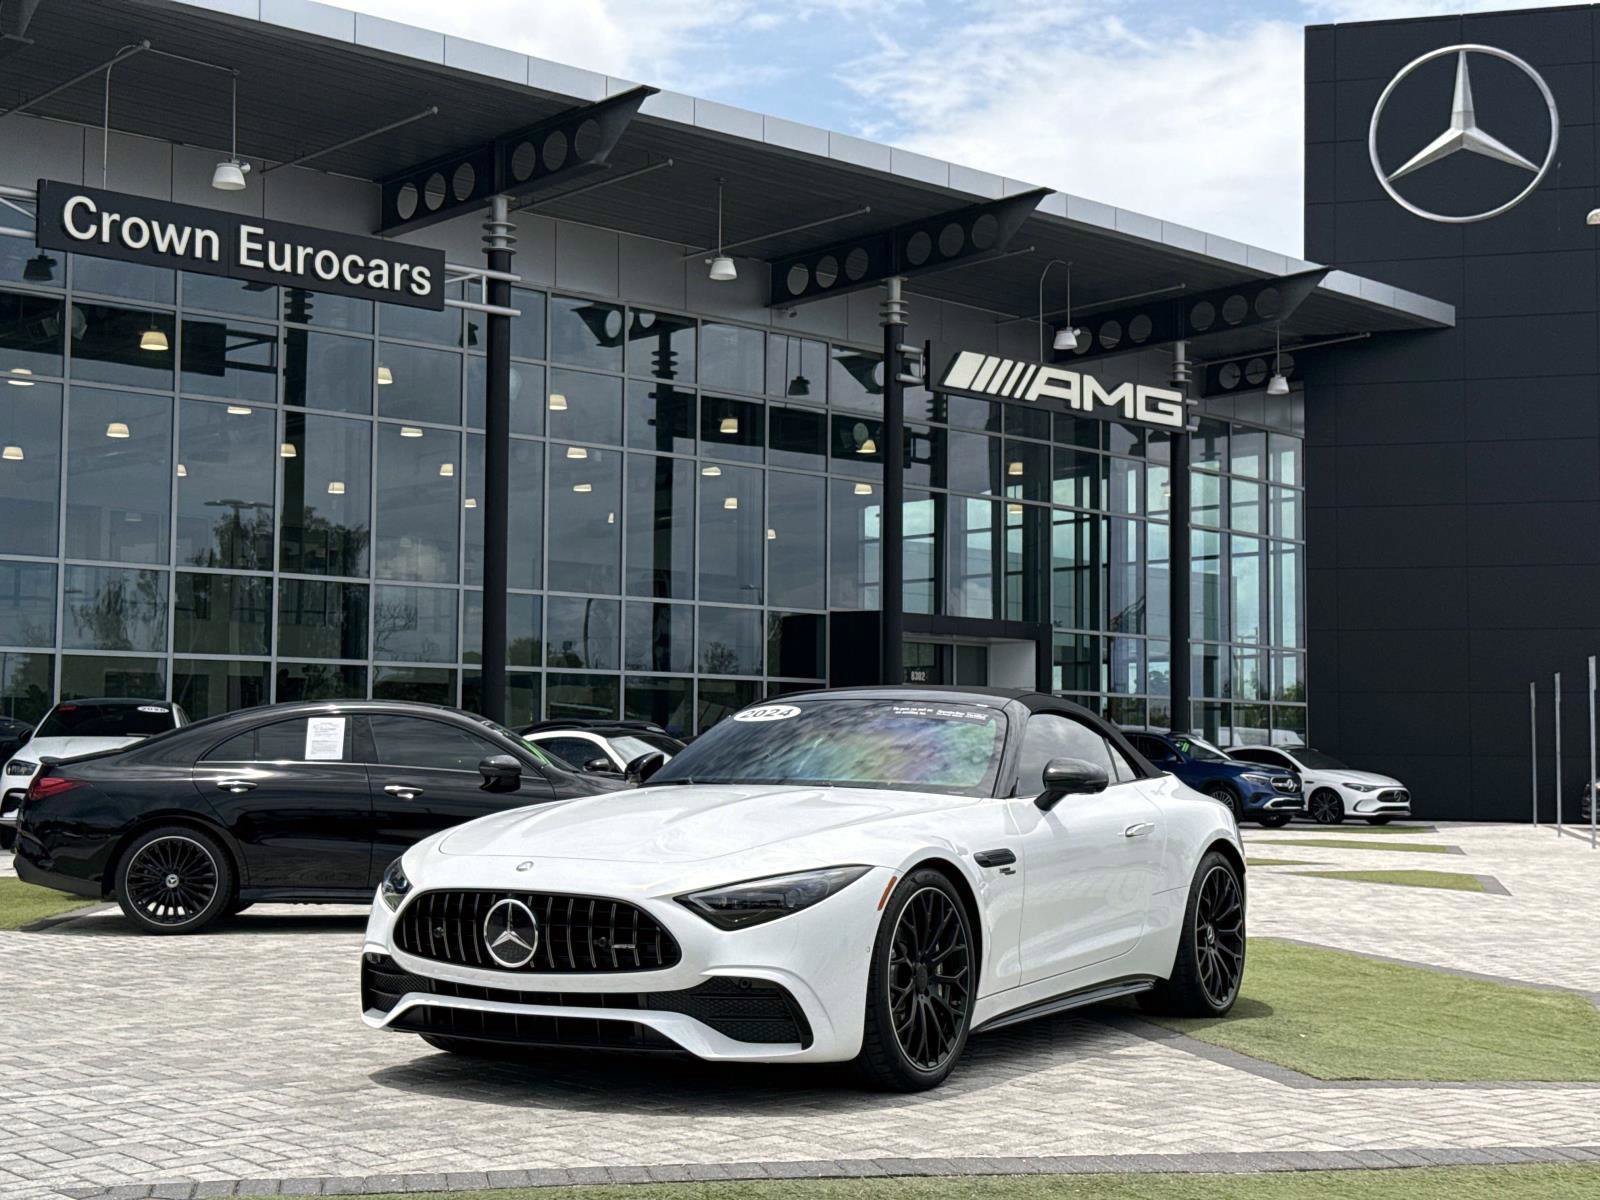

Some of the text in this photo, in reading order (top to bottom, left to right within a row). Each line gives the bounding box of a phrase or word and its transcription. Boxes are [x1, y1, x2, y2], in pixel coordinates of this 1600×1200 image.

[63, 195, 431, 295] Crown Eurocars
[1024, 366, 1183, 427] AMG
[739, 708, 795, 719] 2024
